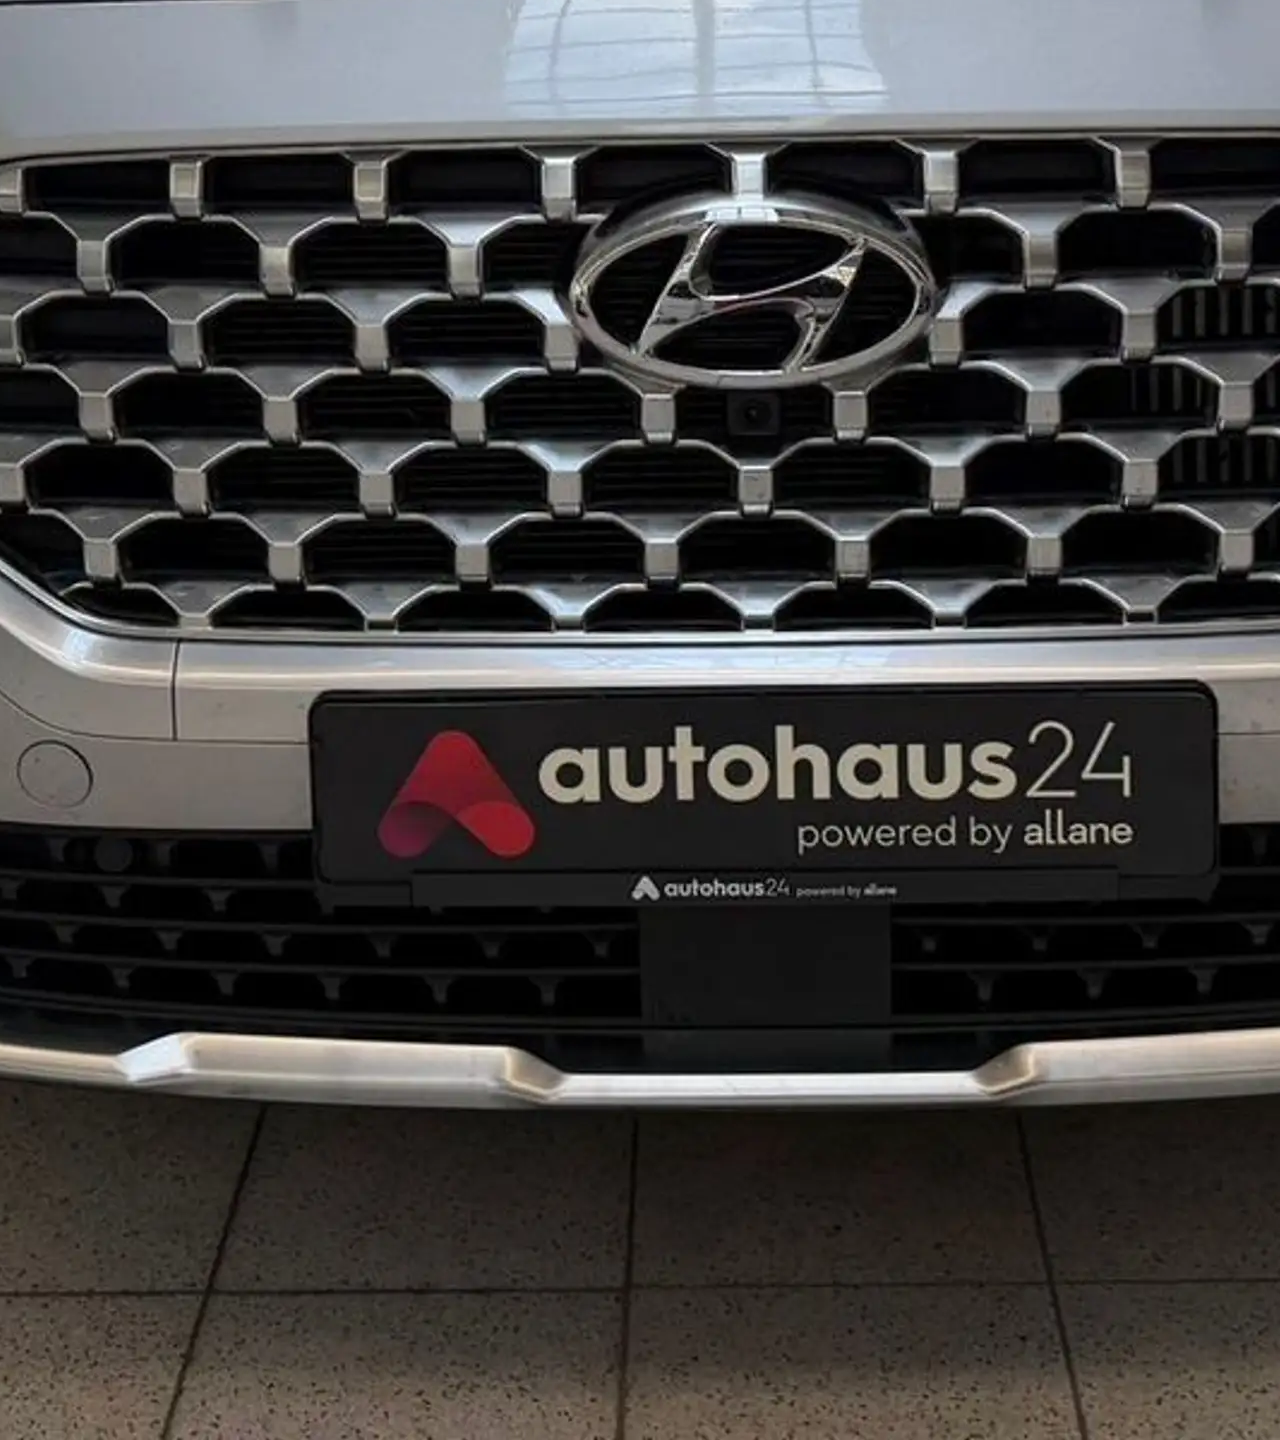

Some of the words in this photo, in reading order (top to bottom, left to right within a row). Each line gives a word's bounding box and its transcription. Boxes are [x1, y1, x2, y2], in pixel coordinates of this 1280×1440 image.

[538, 720, 1133, 804] autohaus24
[797, 816, 957, 854] powered
[970, 817, 1013, 854] by
[1024, 808, 1134, 846] allane
[663, 877, 791, 898] autohaus24
